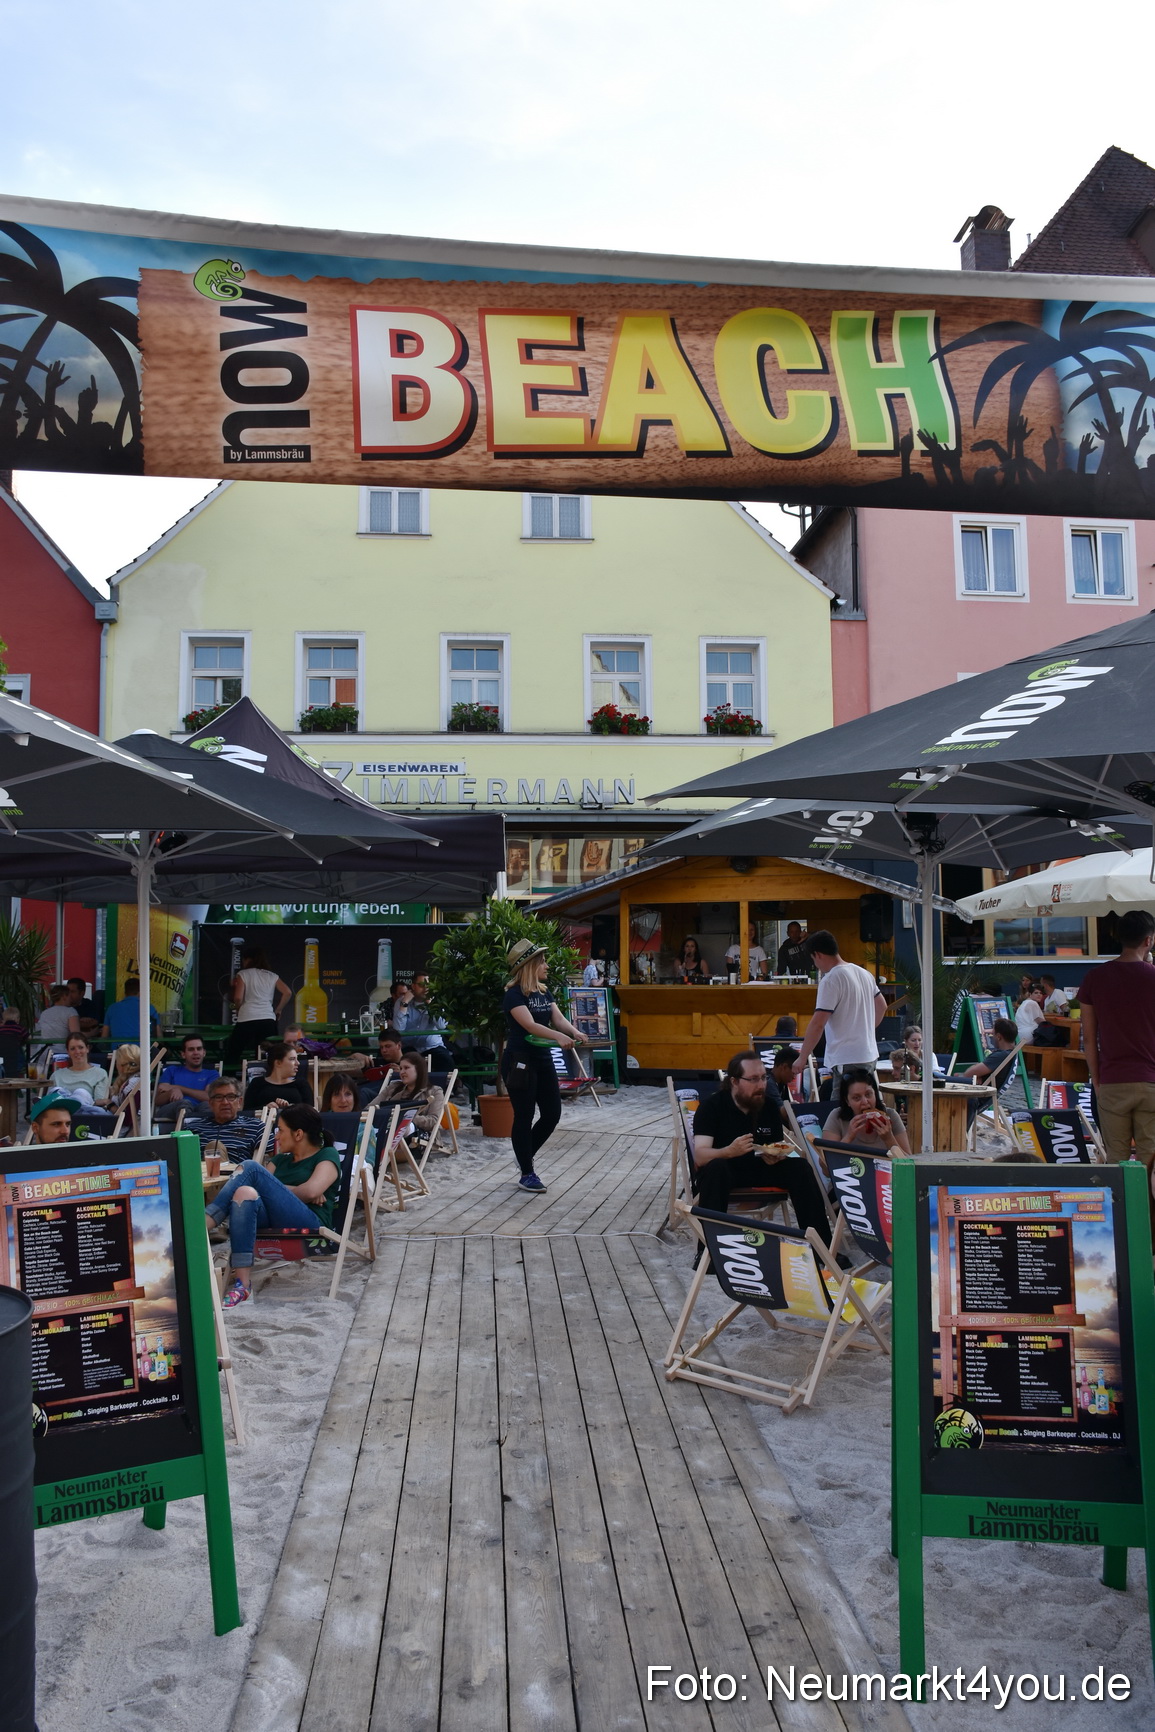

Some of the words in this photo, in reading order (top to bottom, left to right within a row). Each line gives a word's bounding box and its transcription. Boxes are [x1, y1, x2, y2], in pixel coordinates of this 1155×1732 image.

[350, 304, 961, 460] BEACH
[230, 449, 243, 461] by
[245, 447, 305, 461] Lammsbräu
[935, 666, 1115, 745] now
[363, 764, 458, 772] EISENWAREN
[323, 761, 635, 805] ZIMMERMANN
[978, 898, 1002, 910] Tucher
[24, 1174, 110, 1199] BEACH-TIME
[966, 1196, 1052, 1212] BEACH-TIME
[76, 1211, 106, 1219] COCKTAILS
[87, 1404, 109, 1415] Singing
[110, 1400, 139, 1412] Barkeeper
[143, 1396, 168, 1406] Cocktails
[1023, 1430, 1045, 1438] Singing
[1047, 1430, 1076, 1440] Barkeeper
[54, 1470, 147, 1498] Neumarkter
[37, 1484, 164, 1526] Lammsbräu
[987, 1502, 1081, 1520] Neumarkter
[968, 1516, 1100, 1542] Lammsbräu
